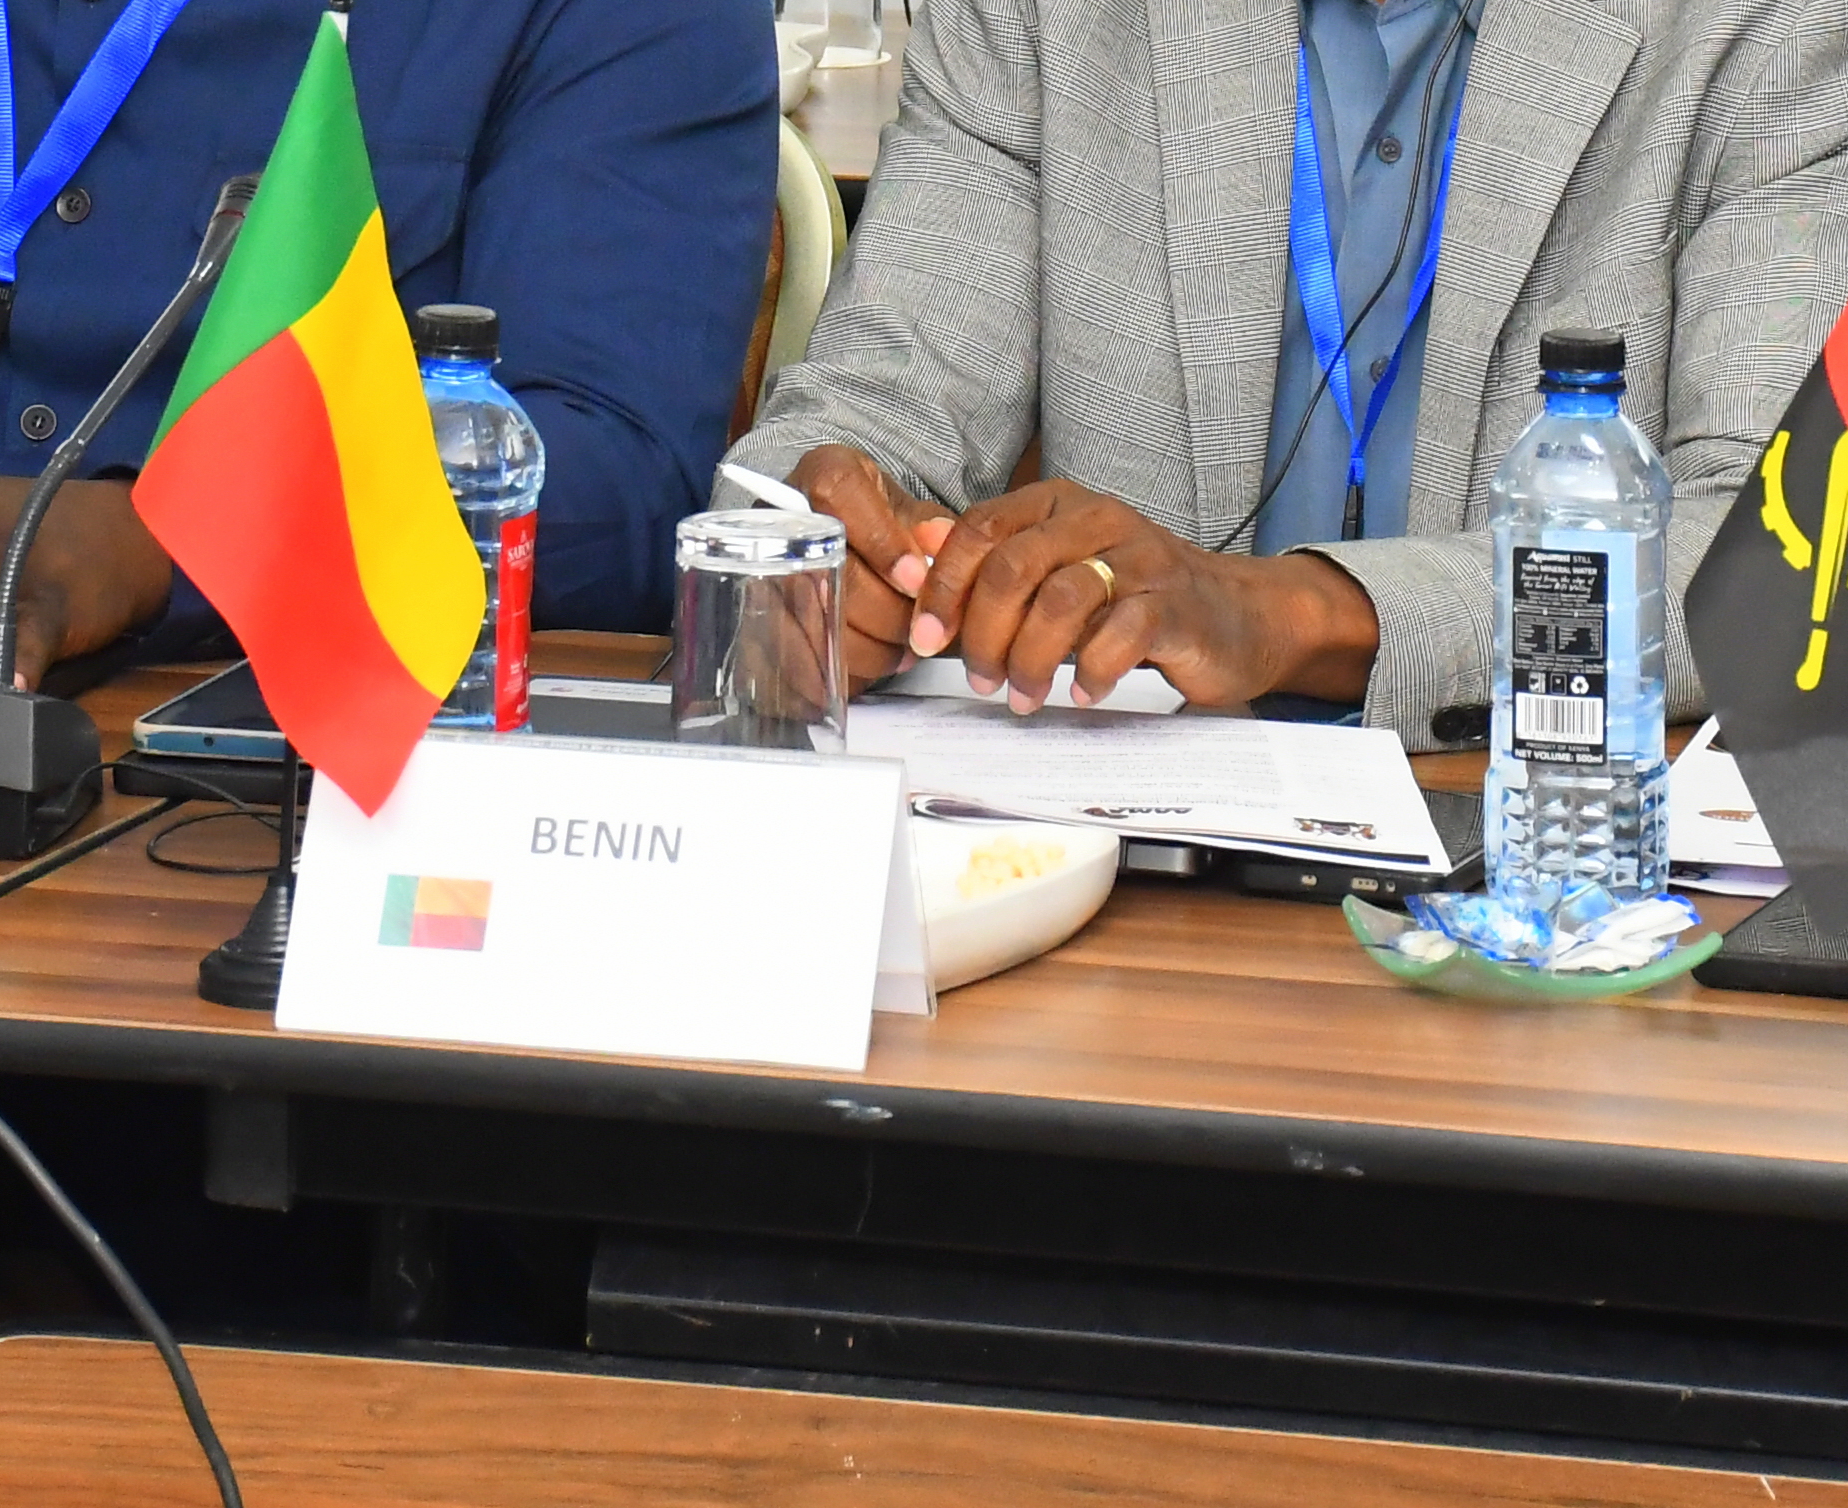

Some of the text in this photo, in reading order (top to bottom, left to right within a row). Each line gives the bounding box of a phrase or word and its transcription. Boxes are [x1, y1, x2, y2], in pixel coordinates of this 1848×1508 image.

[1572, 555, 1592, 564] STILL
[1540, 565, 1571, 573] MINERAL
[1572, 566, 1598, 575] WATER
[1515, 748, 1532, 759] NET
[1533, 750, 1574, 762] VOLUME:
[530, 816, 684, 864] BENIN
